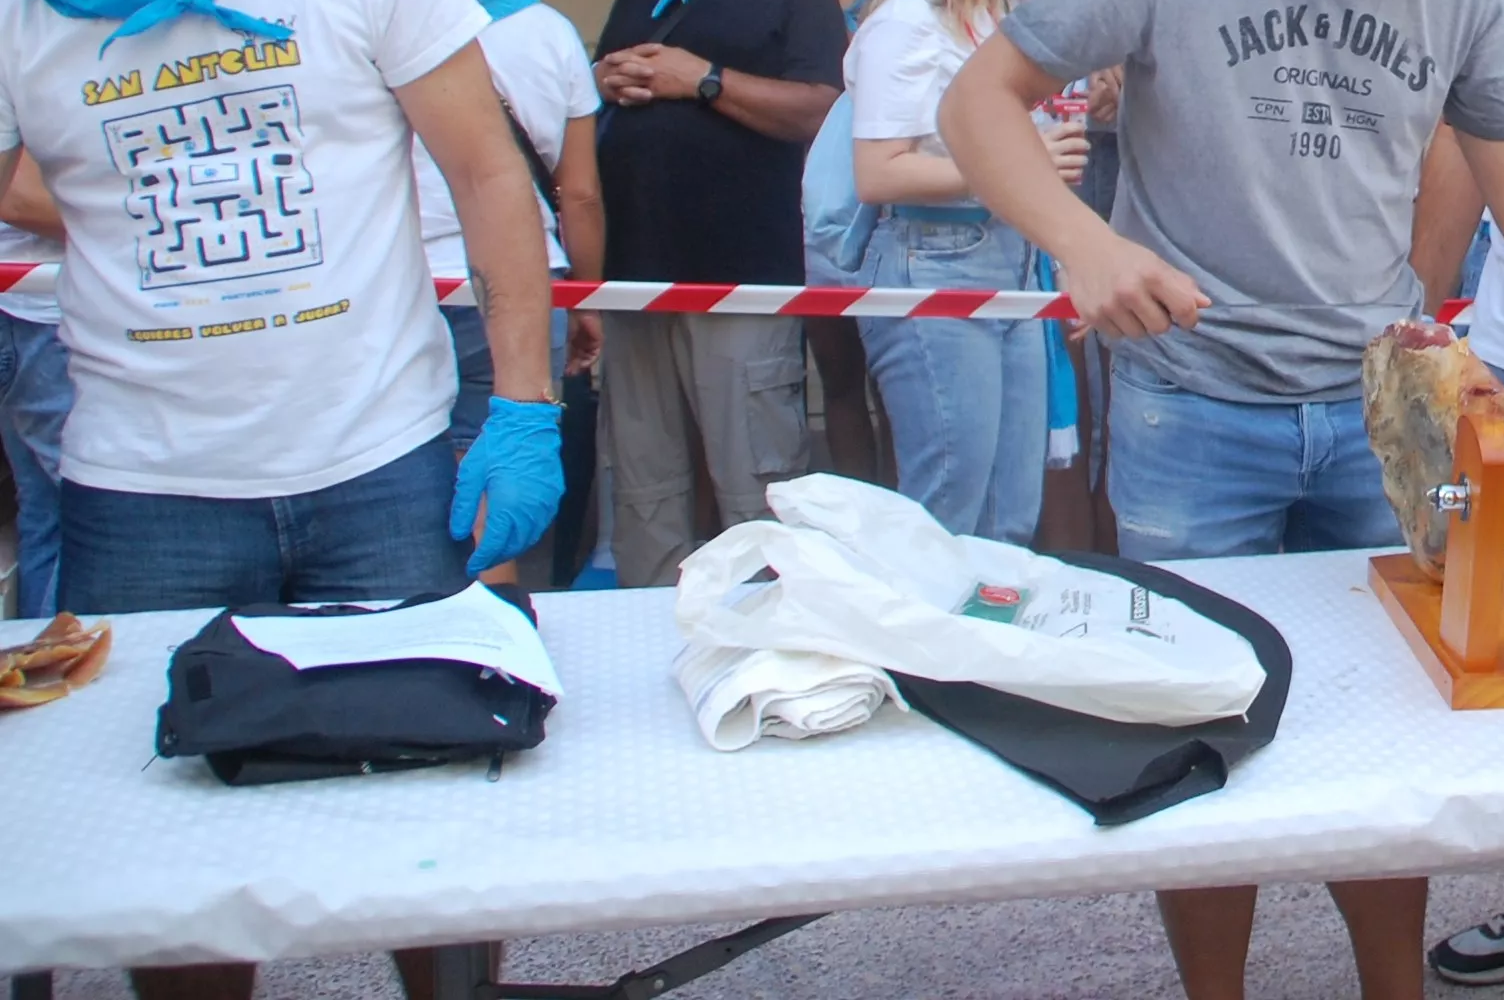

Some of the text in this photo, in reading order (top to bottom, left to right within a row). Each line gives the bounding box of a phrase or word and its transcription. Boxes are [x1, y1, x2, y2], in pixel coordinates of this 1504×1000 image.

[1218, 4, 1436, 92] JACK & JONES
[82, 68, 144, 106] SAN
[1273, 65, 1373, 97] ORIGINALS
[1254, 102, 1285, 116] CPN
[1346, 113, 1378, 128] HGN
[1289, 131, 1341, 160] 1990
[272, 313, 287, 328] A
